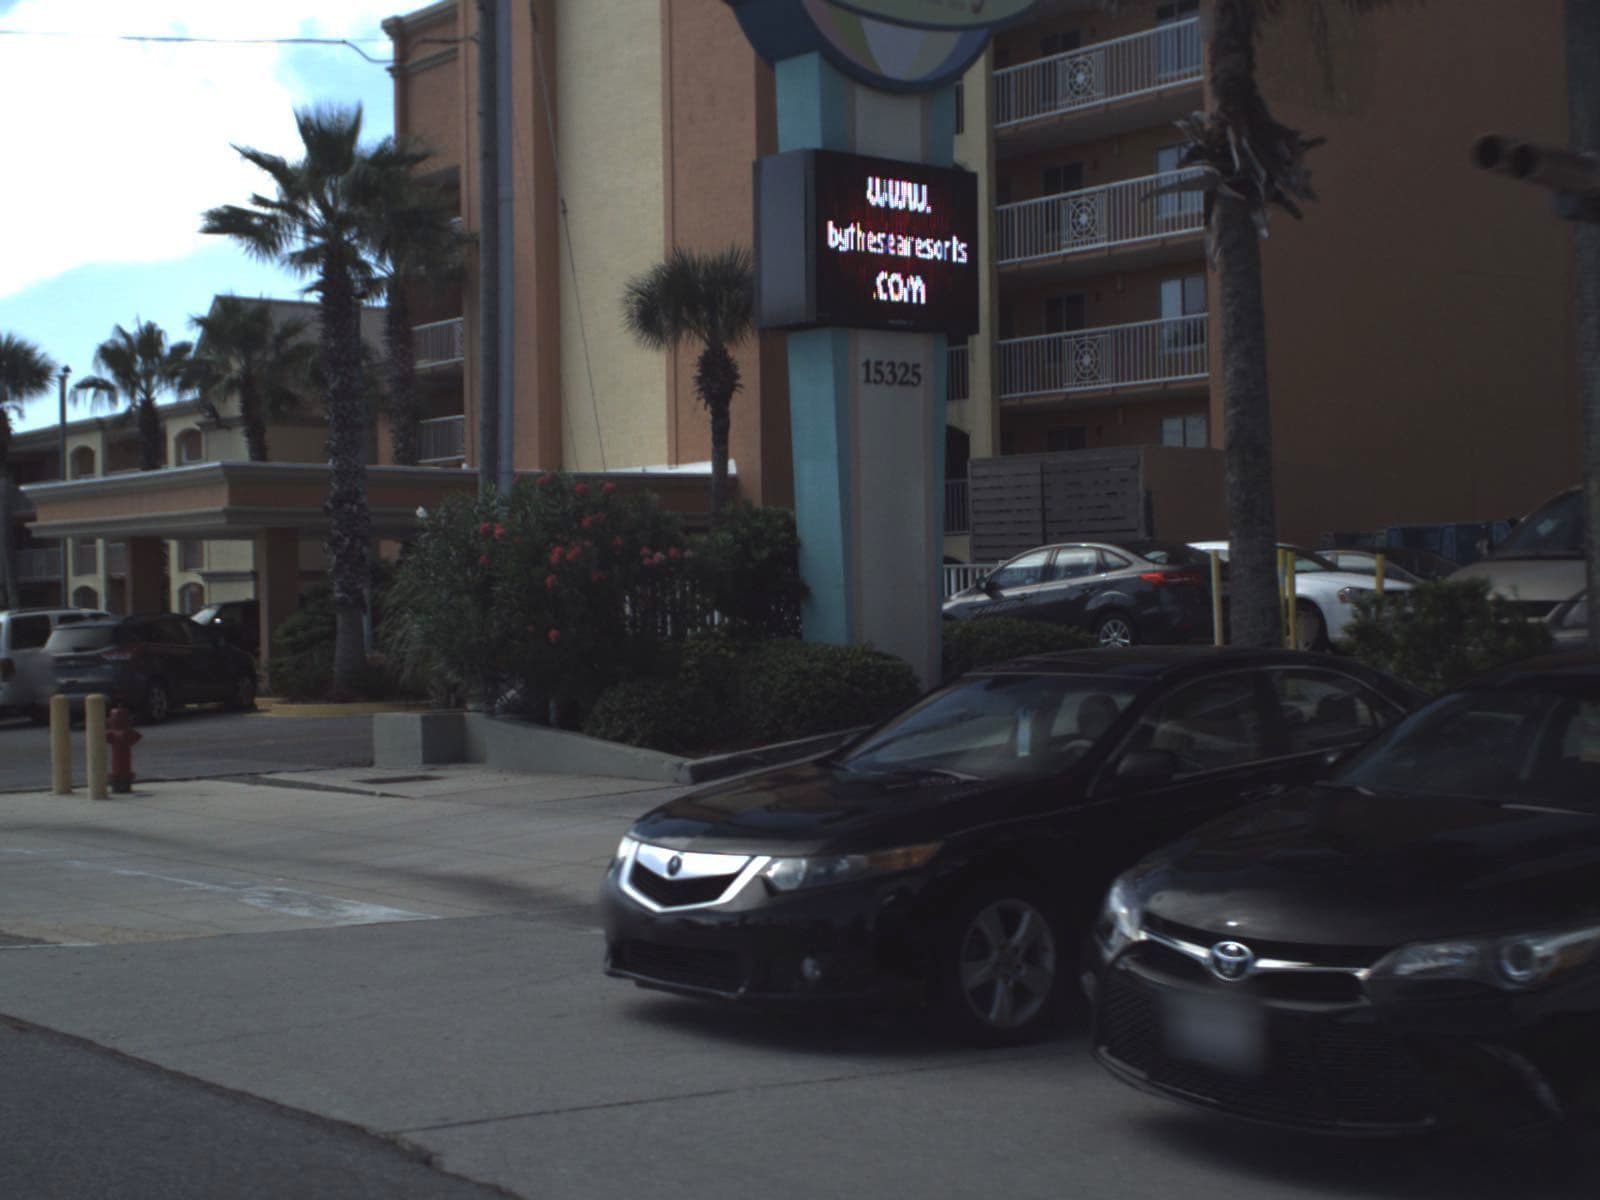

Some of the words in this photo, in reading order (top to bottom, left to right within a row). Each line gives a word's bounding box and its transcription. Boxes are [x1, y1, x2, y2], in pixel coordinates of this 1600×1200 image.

[827, 220, 968, 264] bythesearesorts
[873, 270, 926, 305] .com
[862, 359, 922, 387] 15325
